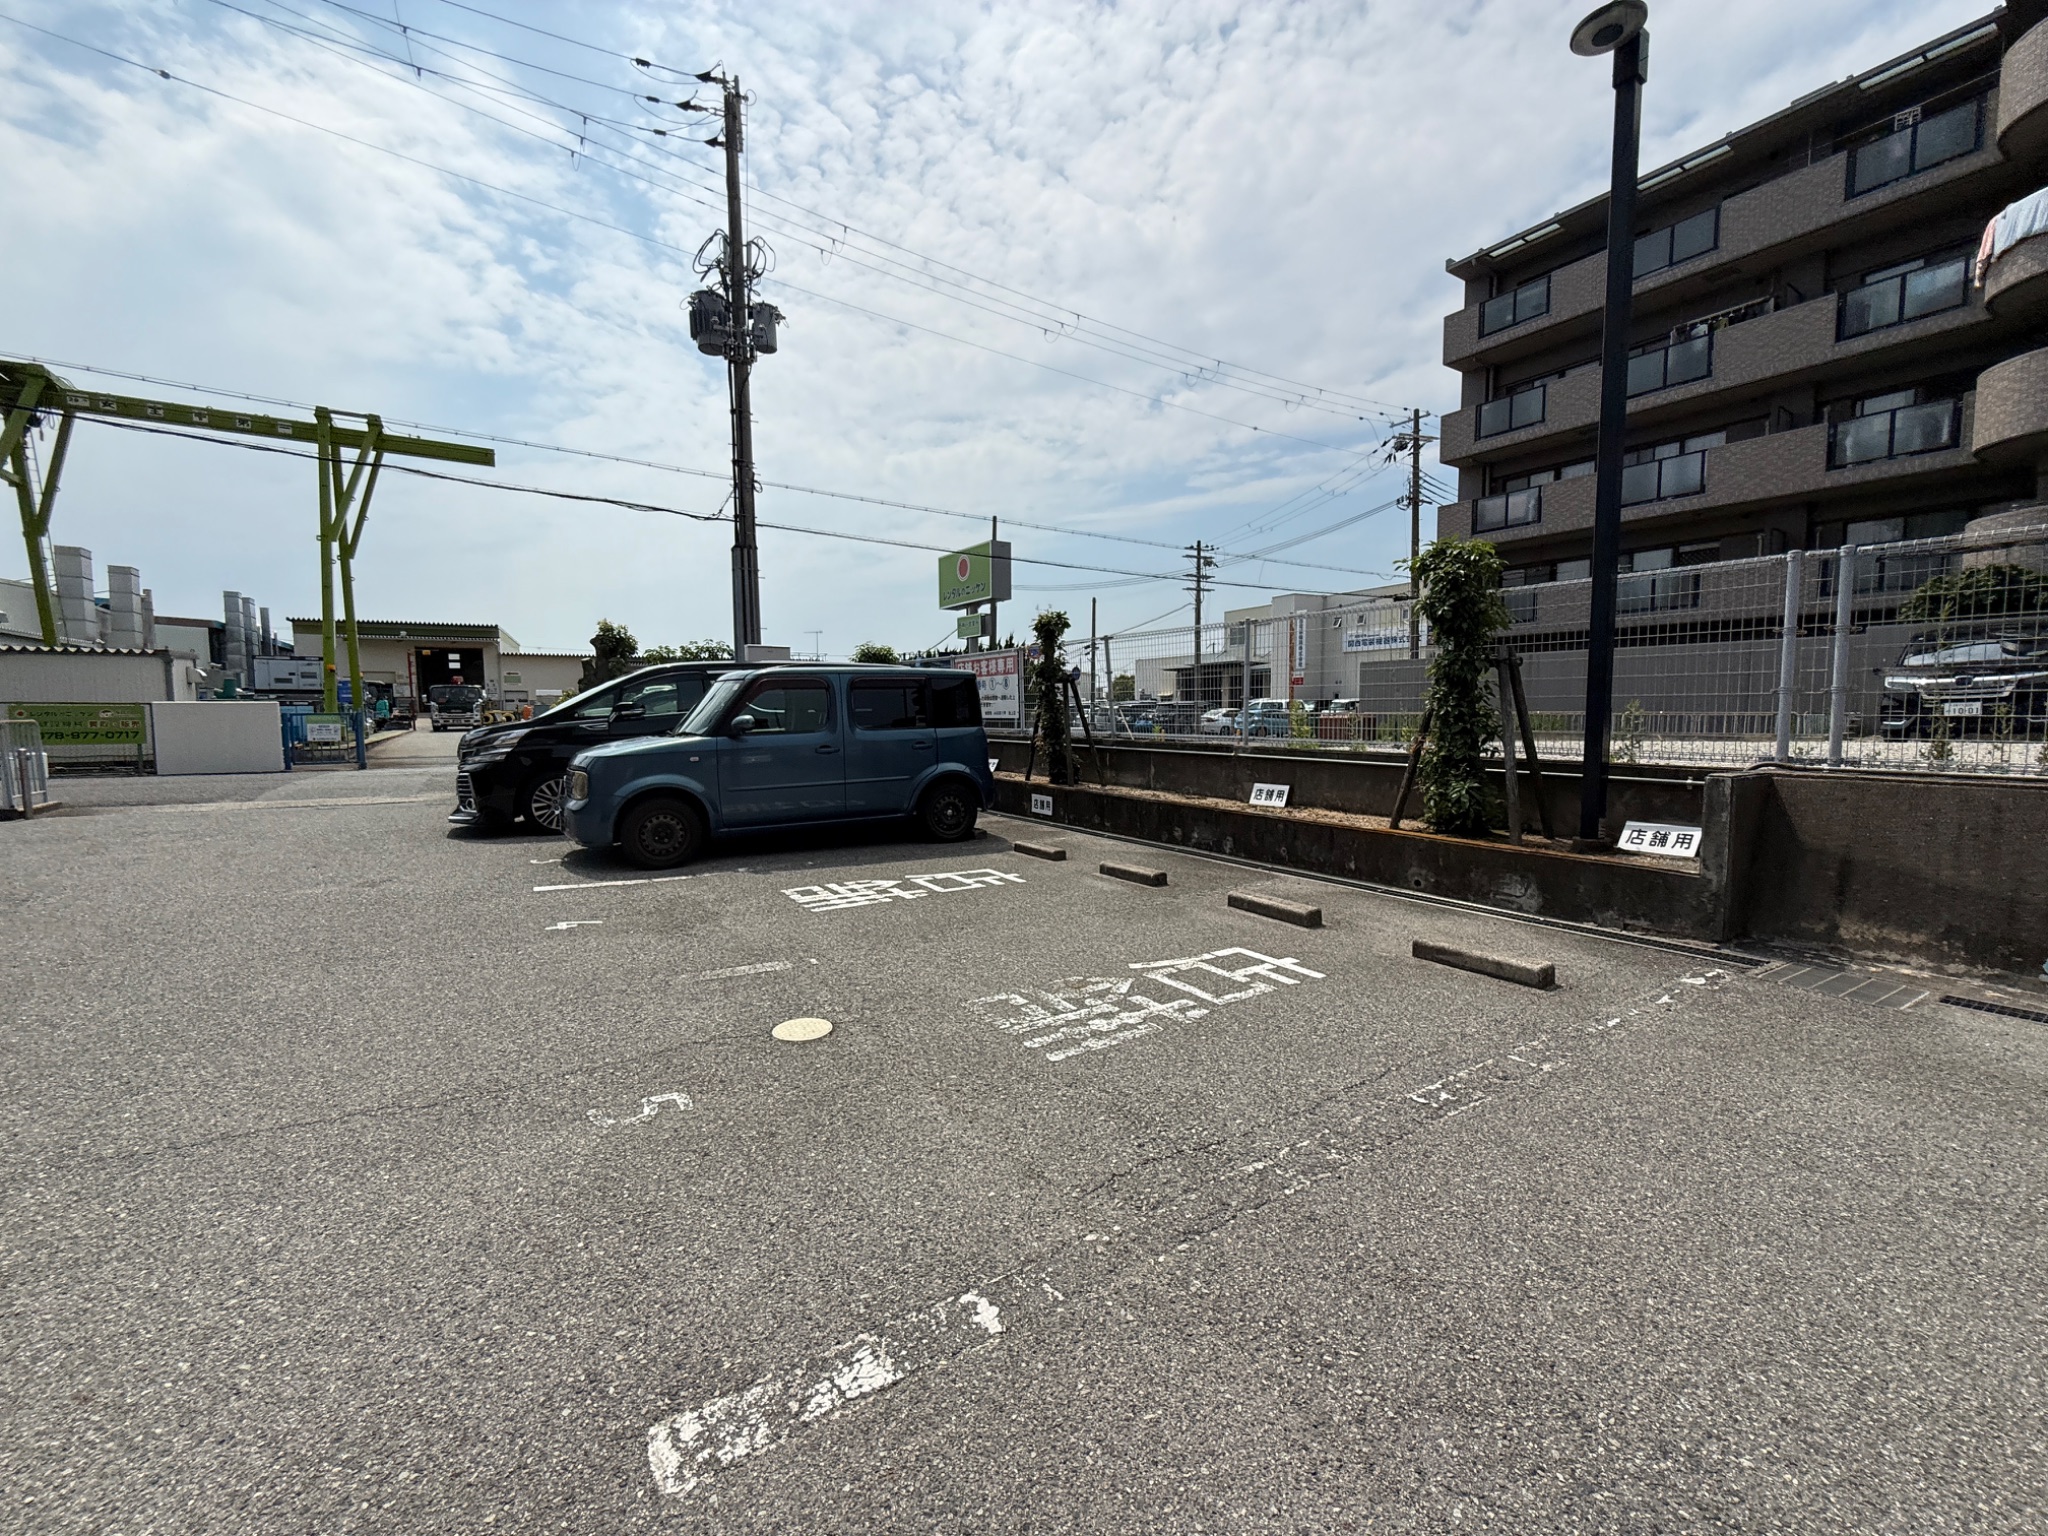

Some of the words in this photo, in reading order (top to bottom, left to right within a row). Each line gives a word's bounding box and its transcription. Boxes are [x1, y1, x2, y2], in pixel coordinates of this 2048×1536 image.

[943, 582, 986, 601] レンタルのニッケン
[1347, 634, 1421, 648] 関西電装機器株式
[40, 731, 140, 740] 78-977-0717
[1252, 787, 1286, 803] 店舗用
[1625, 828, 1695, 850] 店舗用
